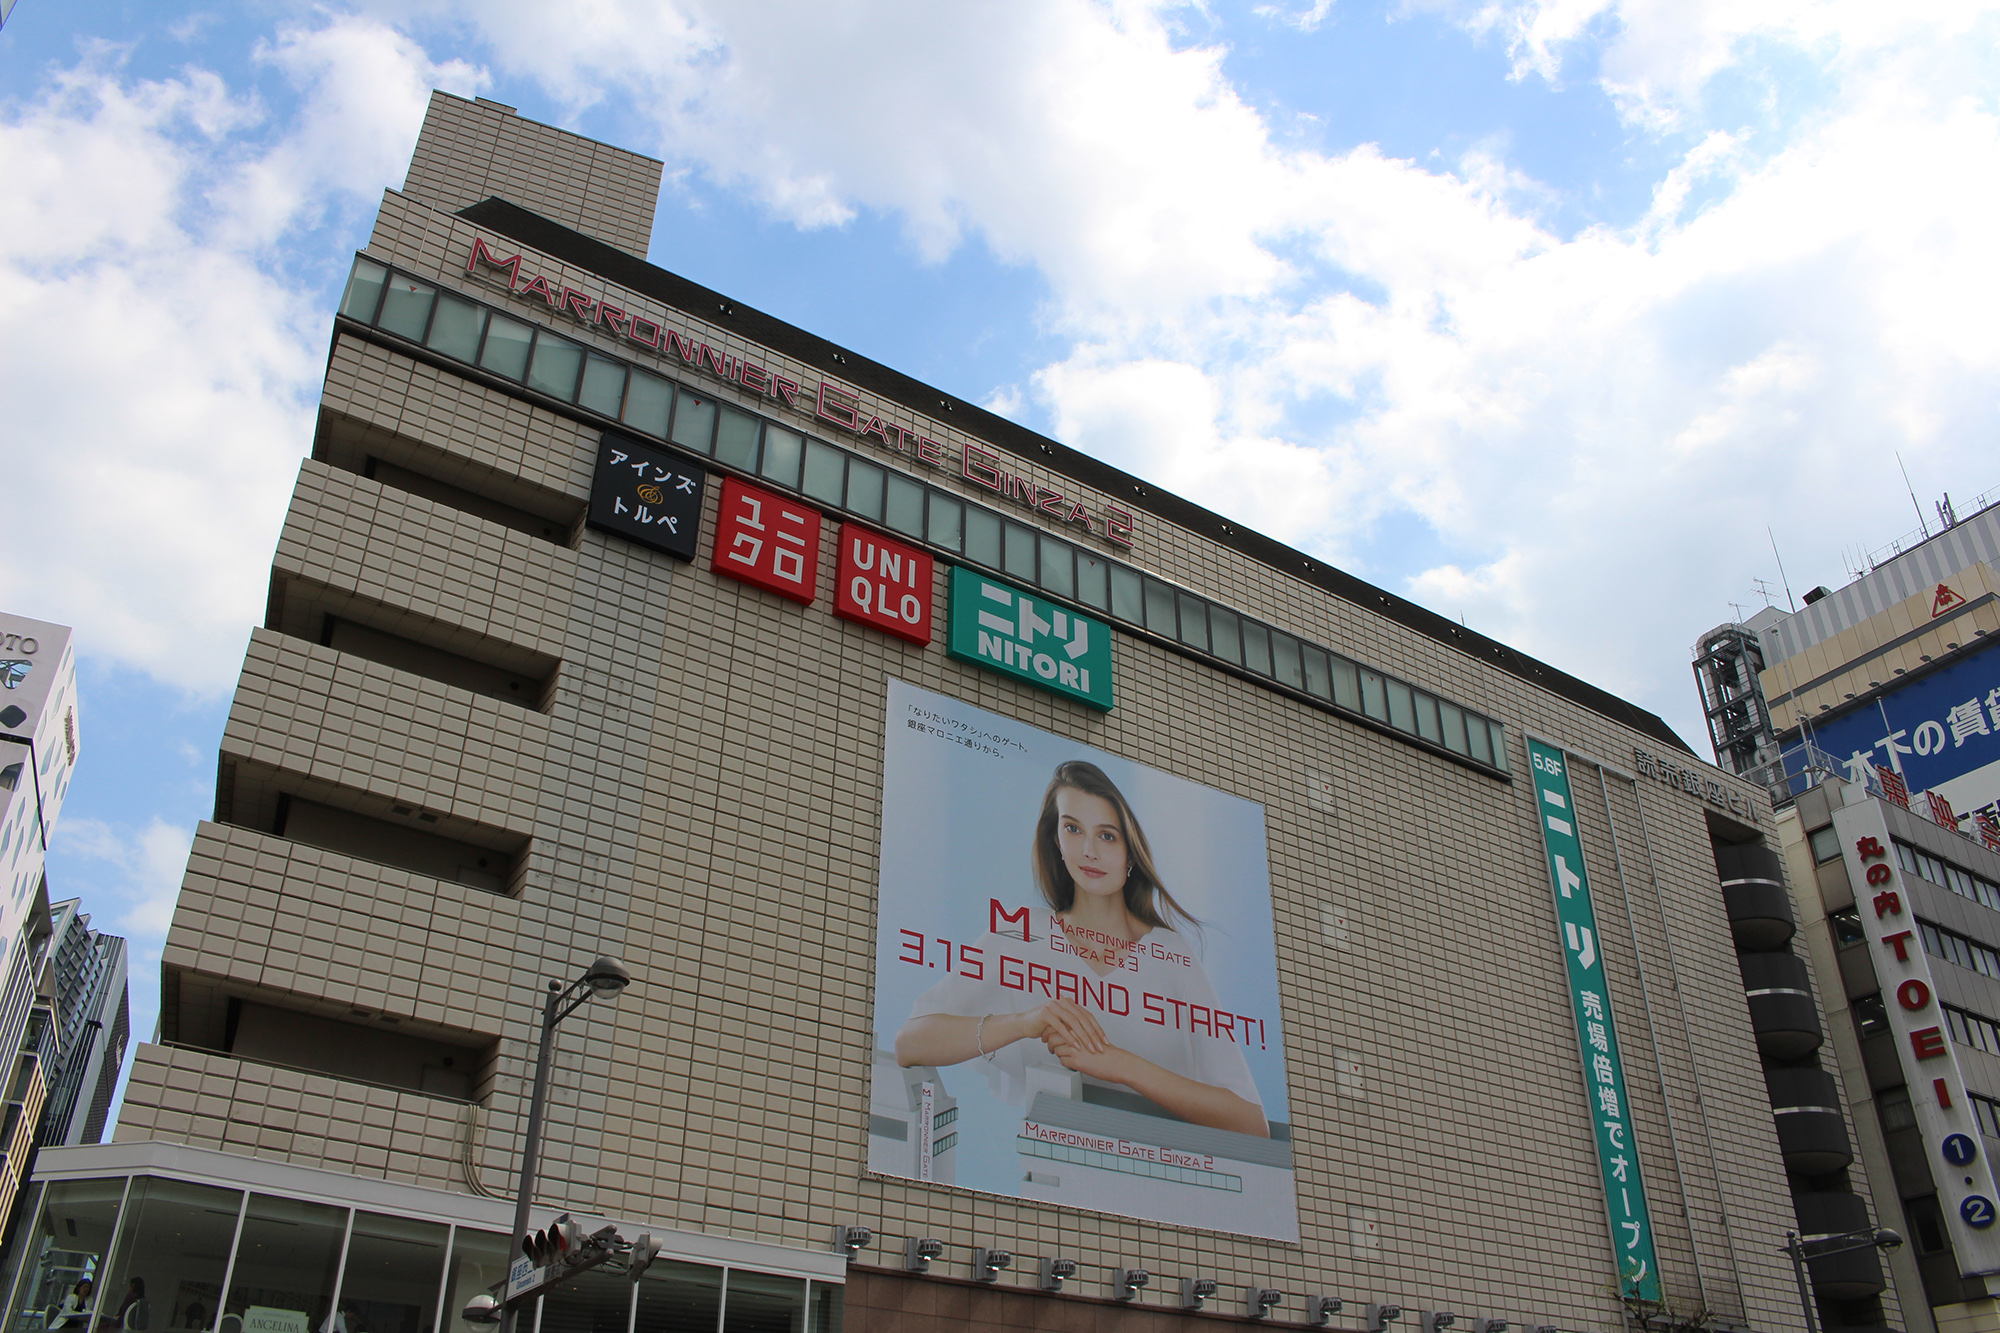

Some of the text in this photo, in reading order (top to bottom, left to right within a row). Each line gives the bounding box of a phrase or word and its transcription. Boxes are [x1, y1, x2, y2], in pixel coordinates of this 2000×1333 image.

[466, 237, 1136, 549] MARRONNIER GATE GINZA 2
[609, 449, 697, 495] アインズ
[614, 496, 679, 535] トルペ
[852, 538, 917, 589] UNI
[850, 575, 922, 625] QLO
[978, 582, 1089, 660] ニトリ
[978, 630, 1090, 693] NITORI
[907, 718, 1004, 760] 銀座マロニエ通りから。
[908, 704, 1028, 753] 「なりたいワタシ」へのゲート。
[1543, 788, 1596, 970] ニトリ
[1050, 915, 1191, 967] MARRONNIER GATE
[1050, 934, 1099, 962] GINZA
[899, 928, 1267, 1051] 3.15 GRAND START!
[1025, 1122, 1214, 1170] MARRONNIER GATE GINZA 2
[1580, 989, 1647, 1283] 売場倍増でオープン
[922, 1155, 931, 1178] GATE
[249, 1318, 299, 1333] ANGELINA
